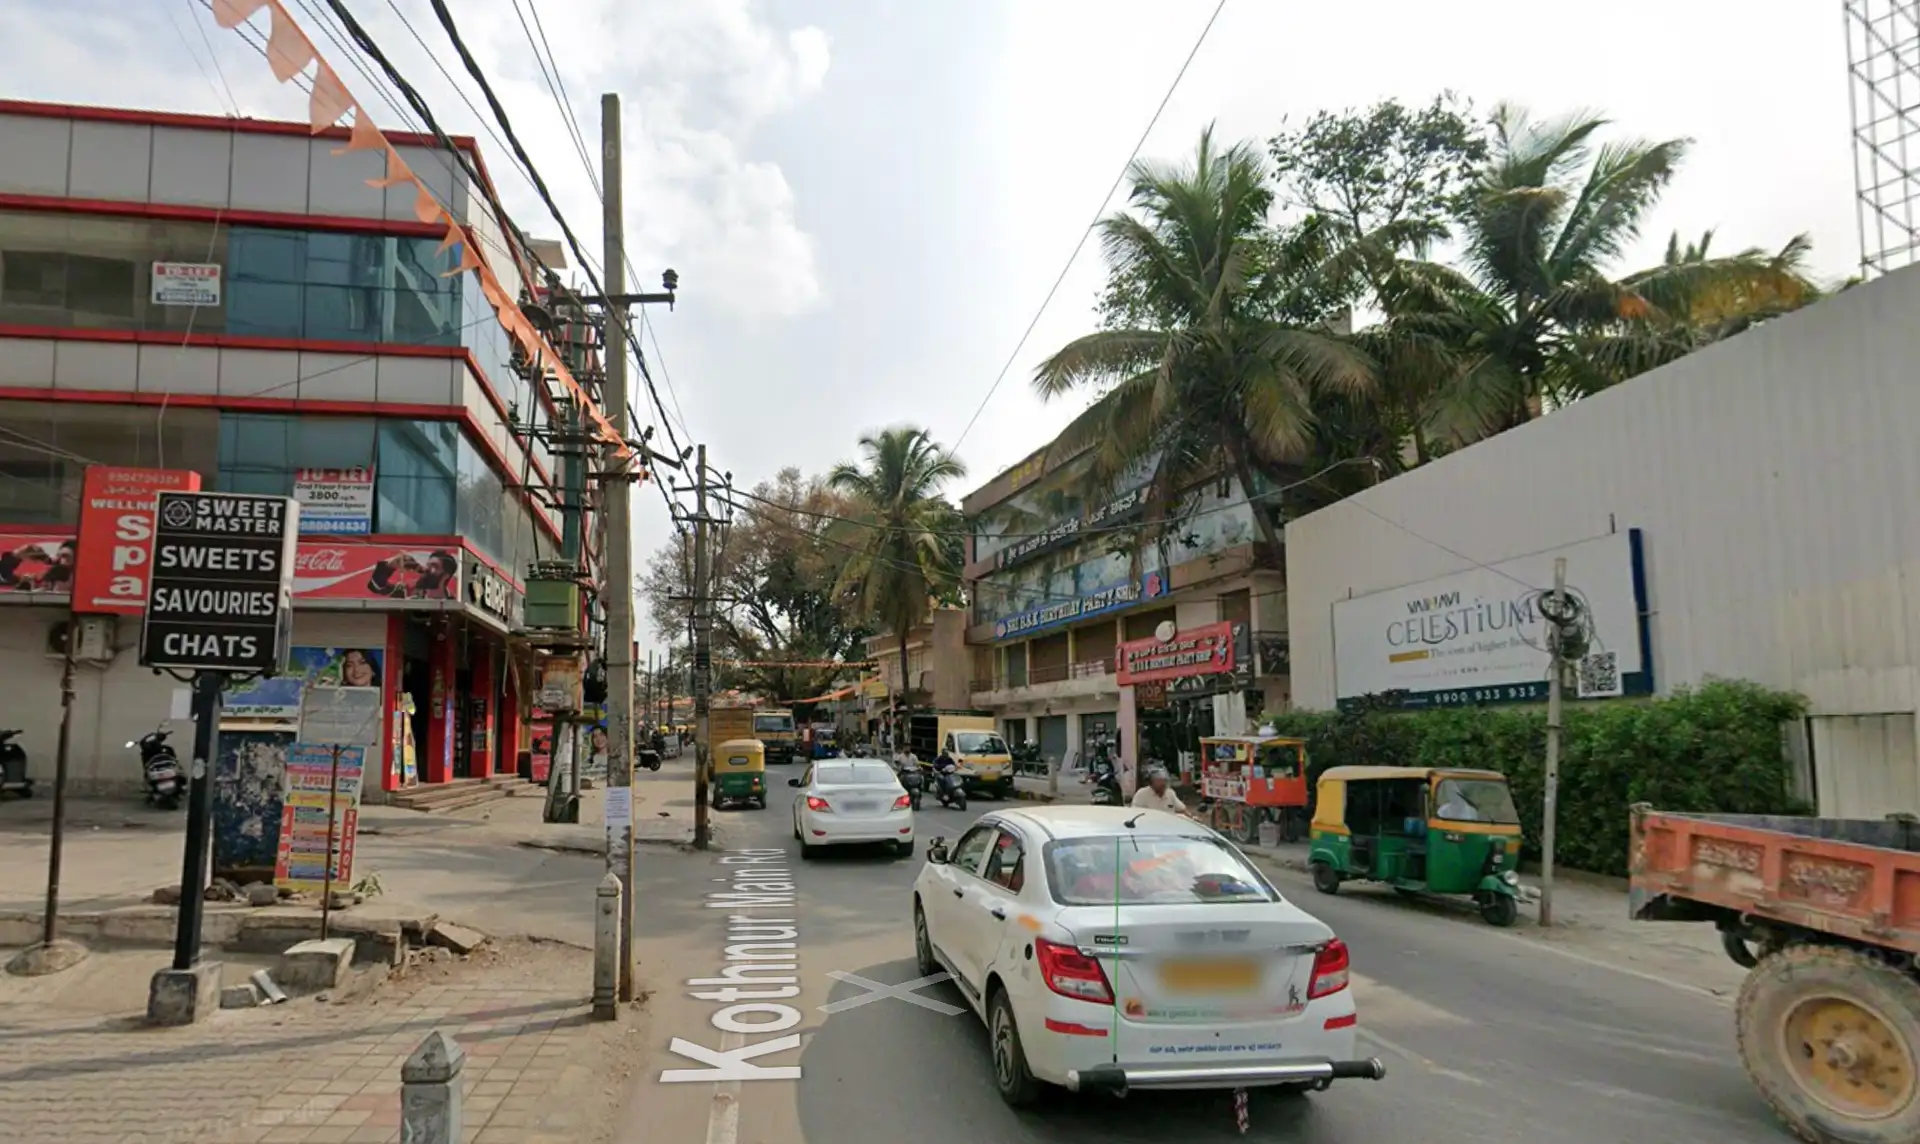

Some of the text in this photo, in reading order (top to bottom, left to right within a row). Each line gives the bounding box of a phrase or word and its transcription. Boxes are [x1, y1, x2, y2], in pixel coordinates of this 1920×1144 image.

[91, 498, 158, 510] WELLNE
[196, 499, 283, 518] SWEET
[195, 516, 280, 534] MASTER
[109, 514, 151, 596] Spa
[160, 545, 276, 571] SWEETS
[153, 587, 275, 616] SAVOURIES
[163, 633, 257, 659] CHATS
